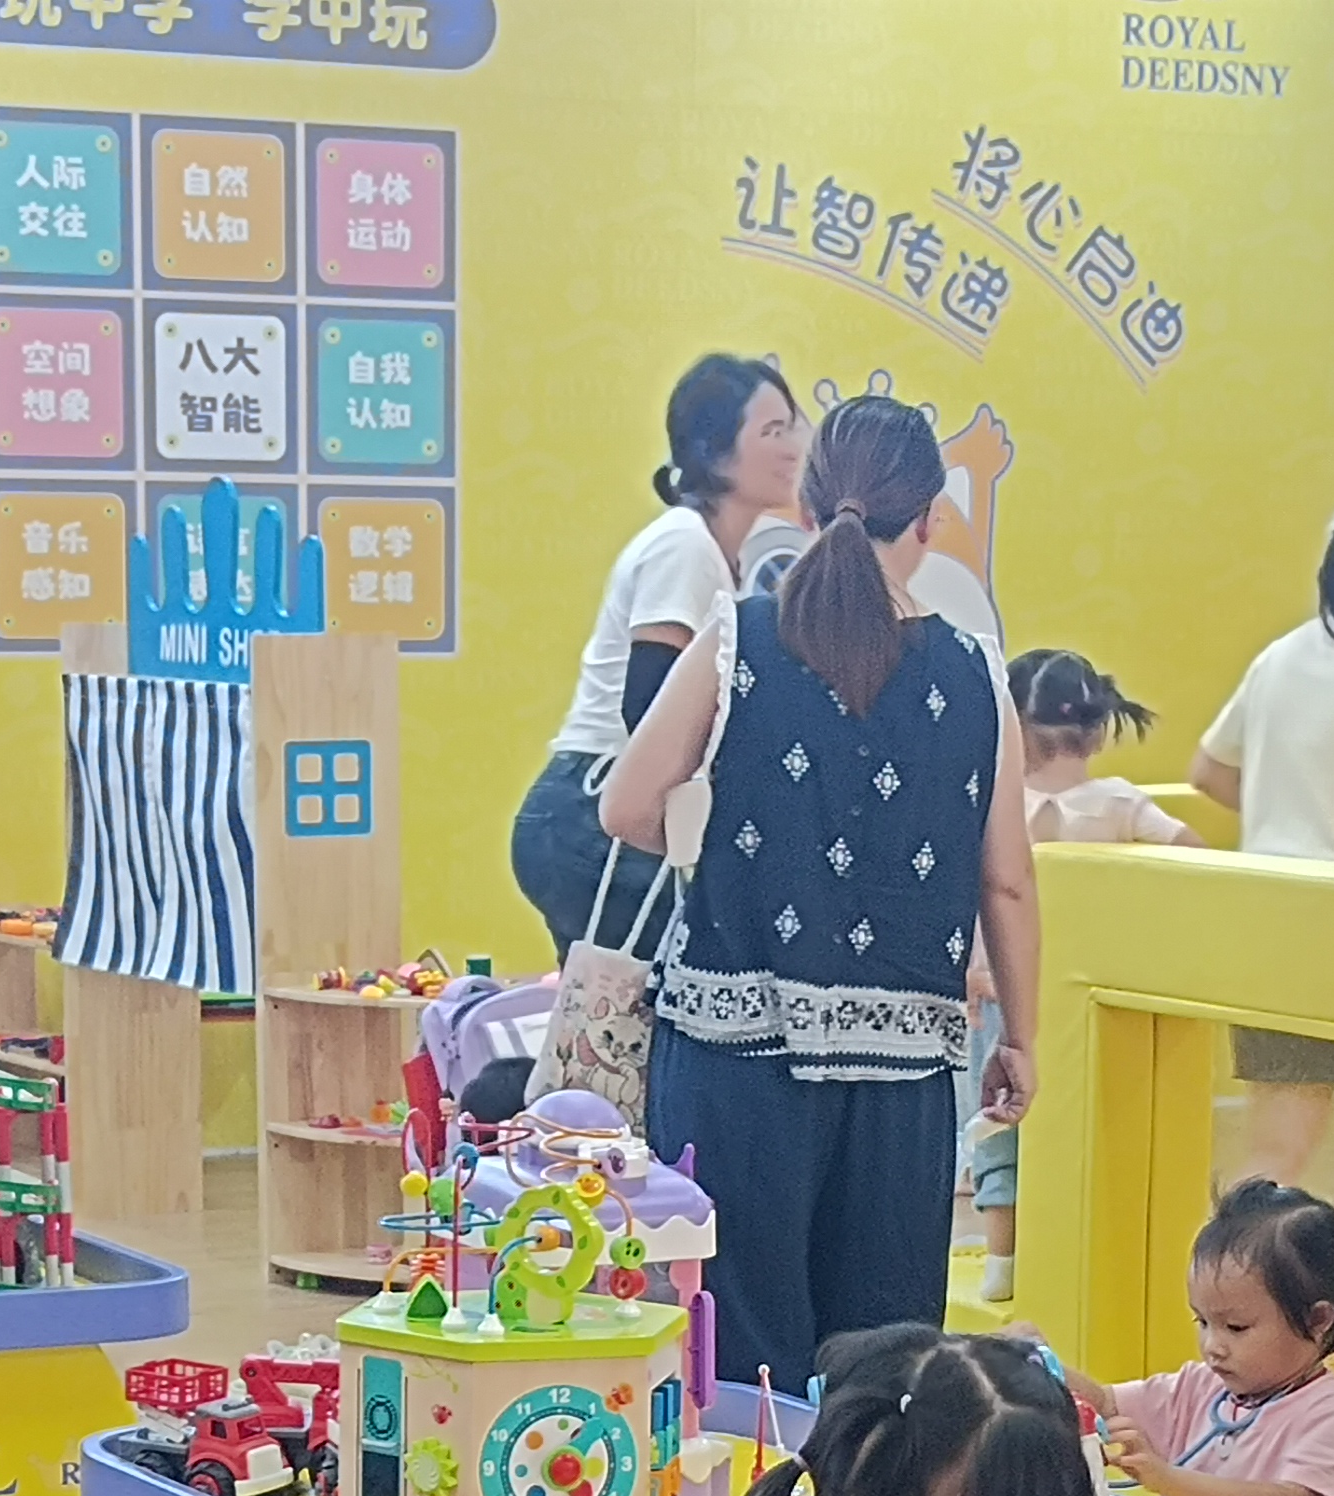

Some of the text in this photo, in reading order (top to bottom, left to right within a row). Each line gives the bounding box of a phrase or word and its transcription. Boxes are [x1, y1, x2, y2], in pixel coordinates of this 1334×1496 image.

[1121, 14, 1246, 53] ROYAL
[1120, 56, 1291, 97] DEEDSNY
[15, 154, 86, 191] 人际
[181, 163, 250, 199] 自然
[347, 170, 413, 206] 身体
[18, 202, 88, 239] 交往
[181, 211, 250, 245] 认知
[347, 218, 412, 252] 运动
[734, 155, 1010, 336] 让智传递
[951, 125, 1185, 368] 将心启迪
[21, 341, 91, 377] 空间
[178, 337, 261, 377] 八大
[347, 351, 412, 385] 自我
[22, 387, 91, 423] 想象
[179, 392, 263, 435] 智能
[346, 398, 412, 430] 认知
[21, 521, 89, 556] 音乐
[21, 568, 91, 601] 感知
[160, 622, 250, 668] MINI SH
[515, 1403, 531, 1415] 11
[548, 1387, 571, 1403] 12
[589, 1403, 596, 1414] 1
[491, 1429, 509, 1442] 10
[611, 1427, 621, 1440] 2
[483, 1460, 495, 1476] 9
[621, 1456, 633, 1471] 3
